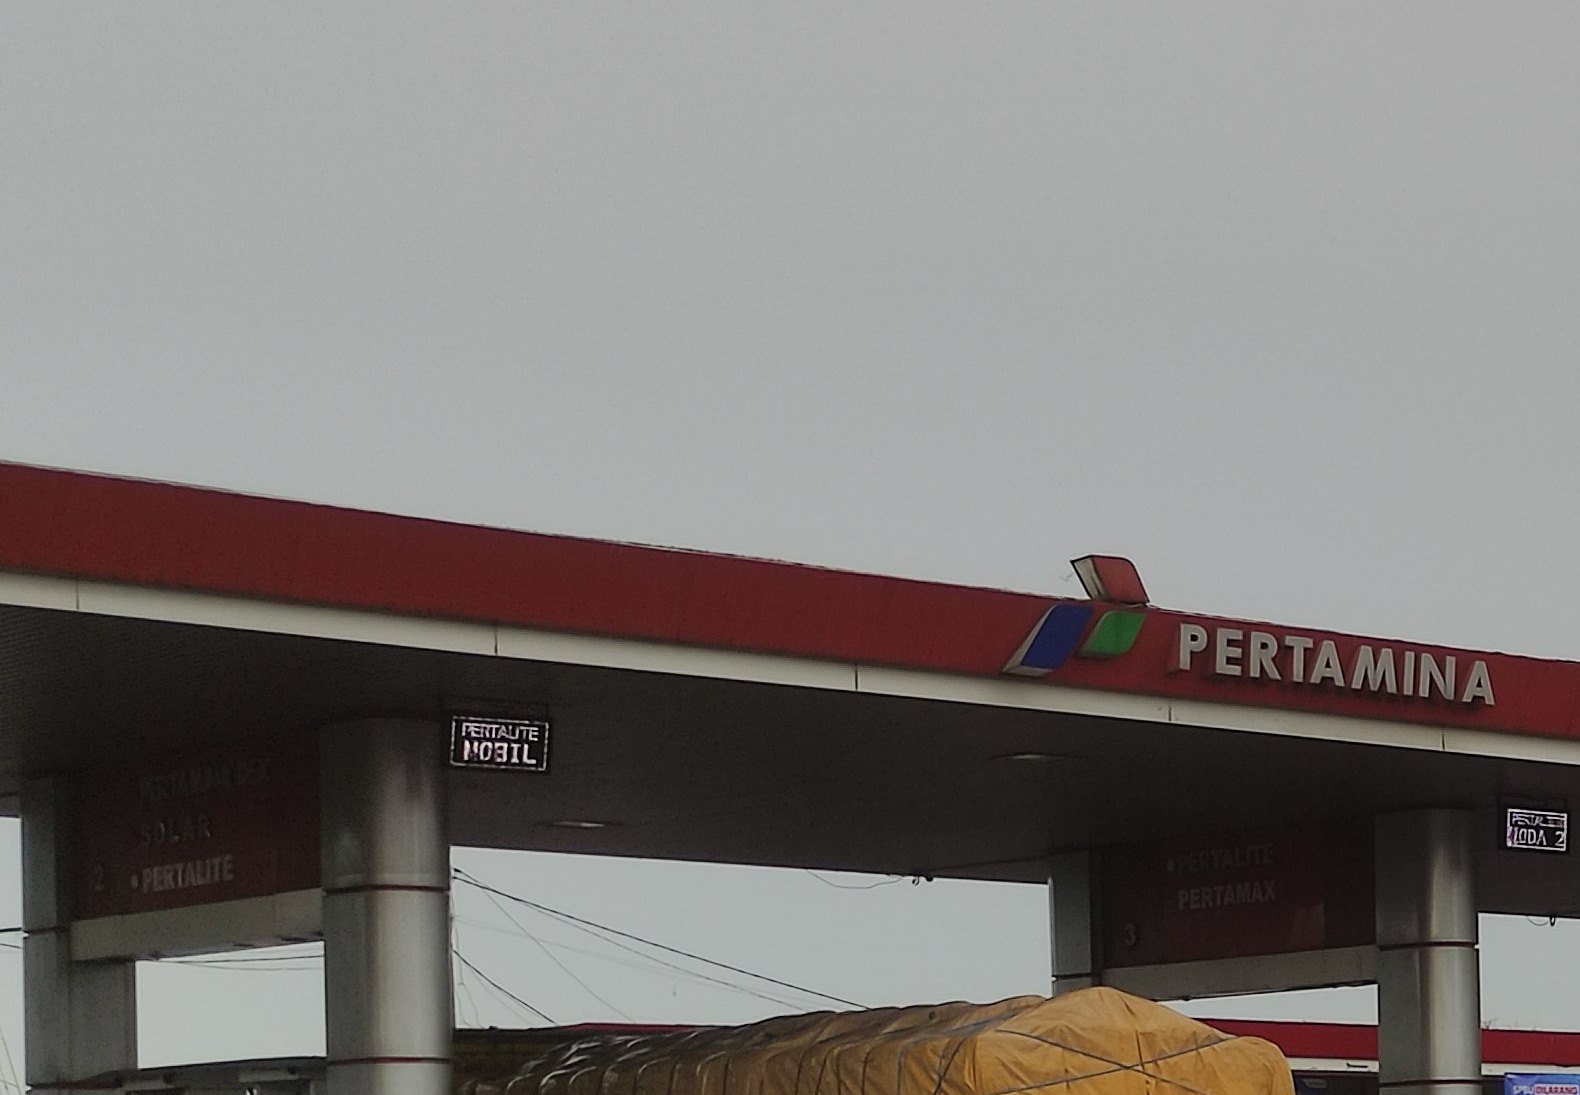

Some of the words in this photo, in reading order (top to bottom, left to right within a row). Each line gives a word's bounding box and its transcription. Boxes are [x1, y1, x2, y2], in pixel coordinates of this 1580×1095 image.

[1178, 622, 1495, 706] PERTAMINA
[141, 813, 212, 846] SOLAR
[1555, 831, 1565, 847] 2
[142, 854, 236, 894] PERTALITE
[1177, 844, 1274, 874] PERTALITE
[1178, 879, 1276, 911] PERTAMAX
[1124, 922, 1137, 947] 3
[1535, 1085, 1578, 1095] DILARANG
